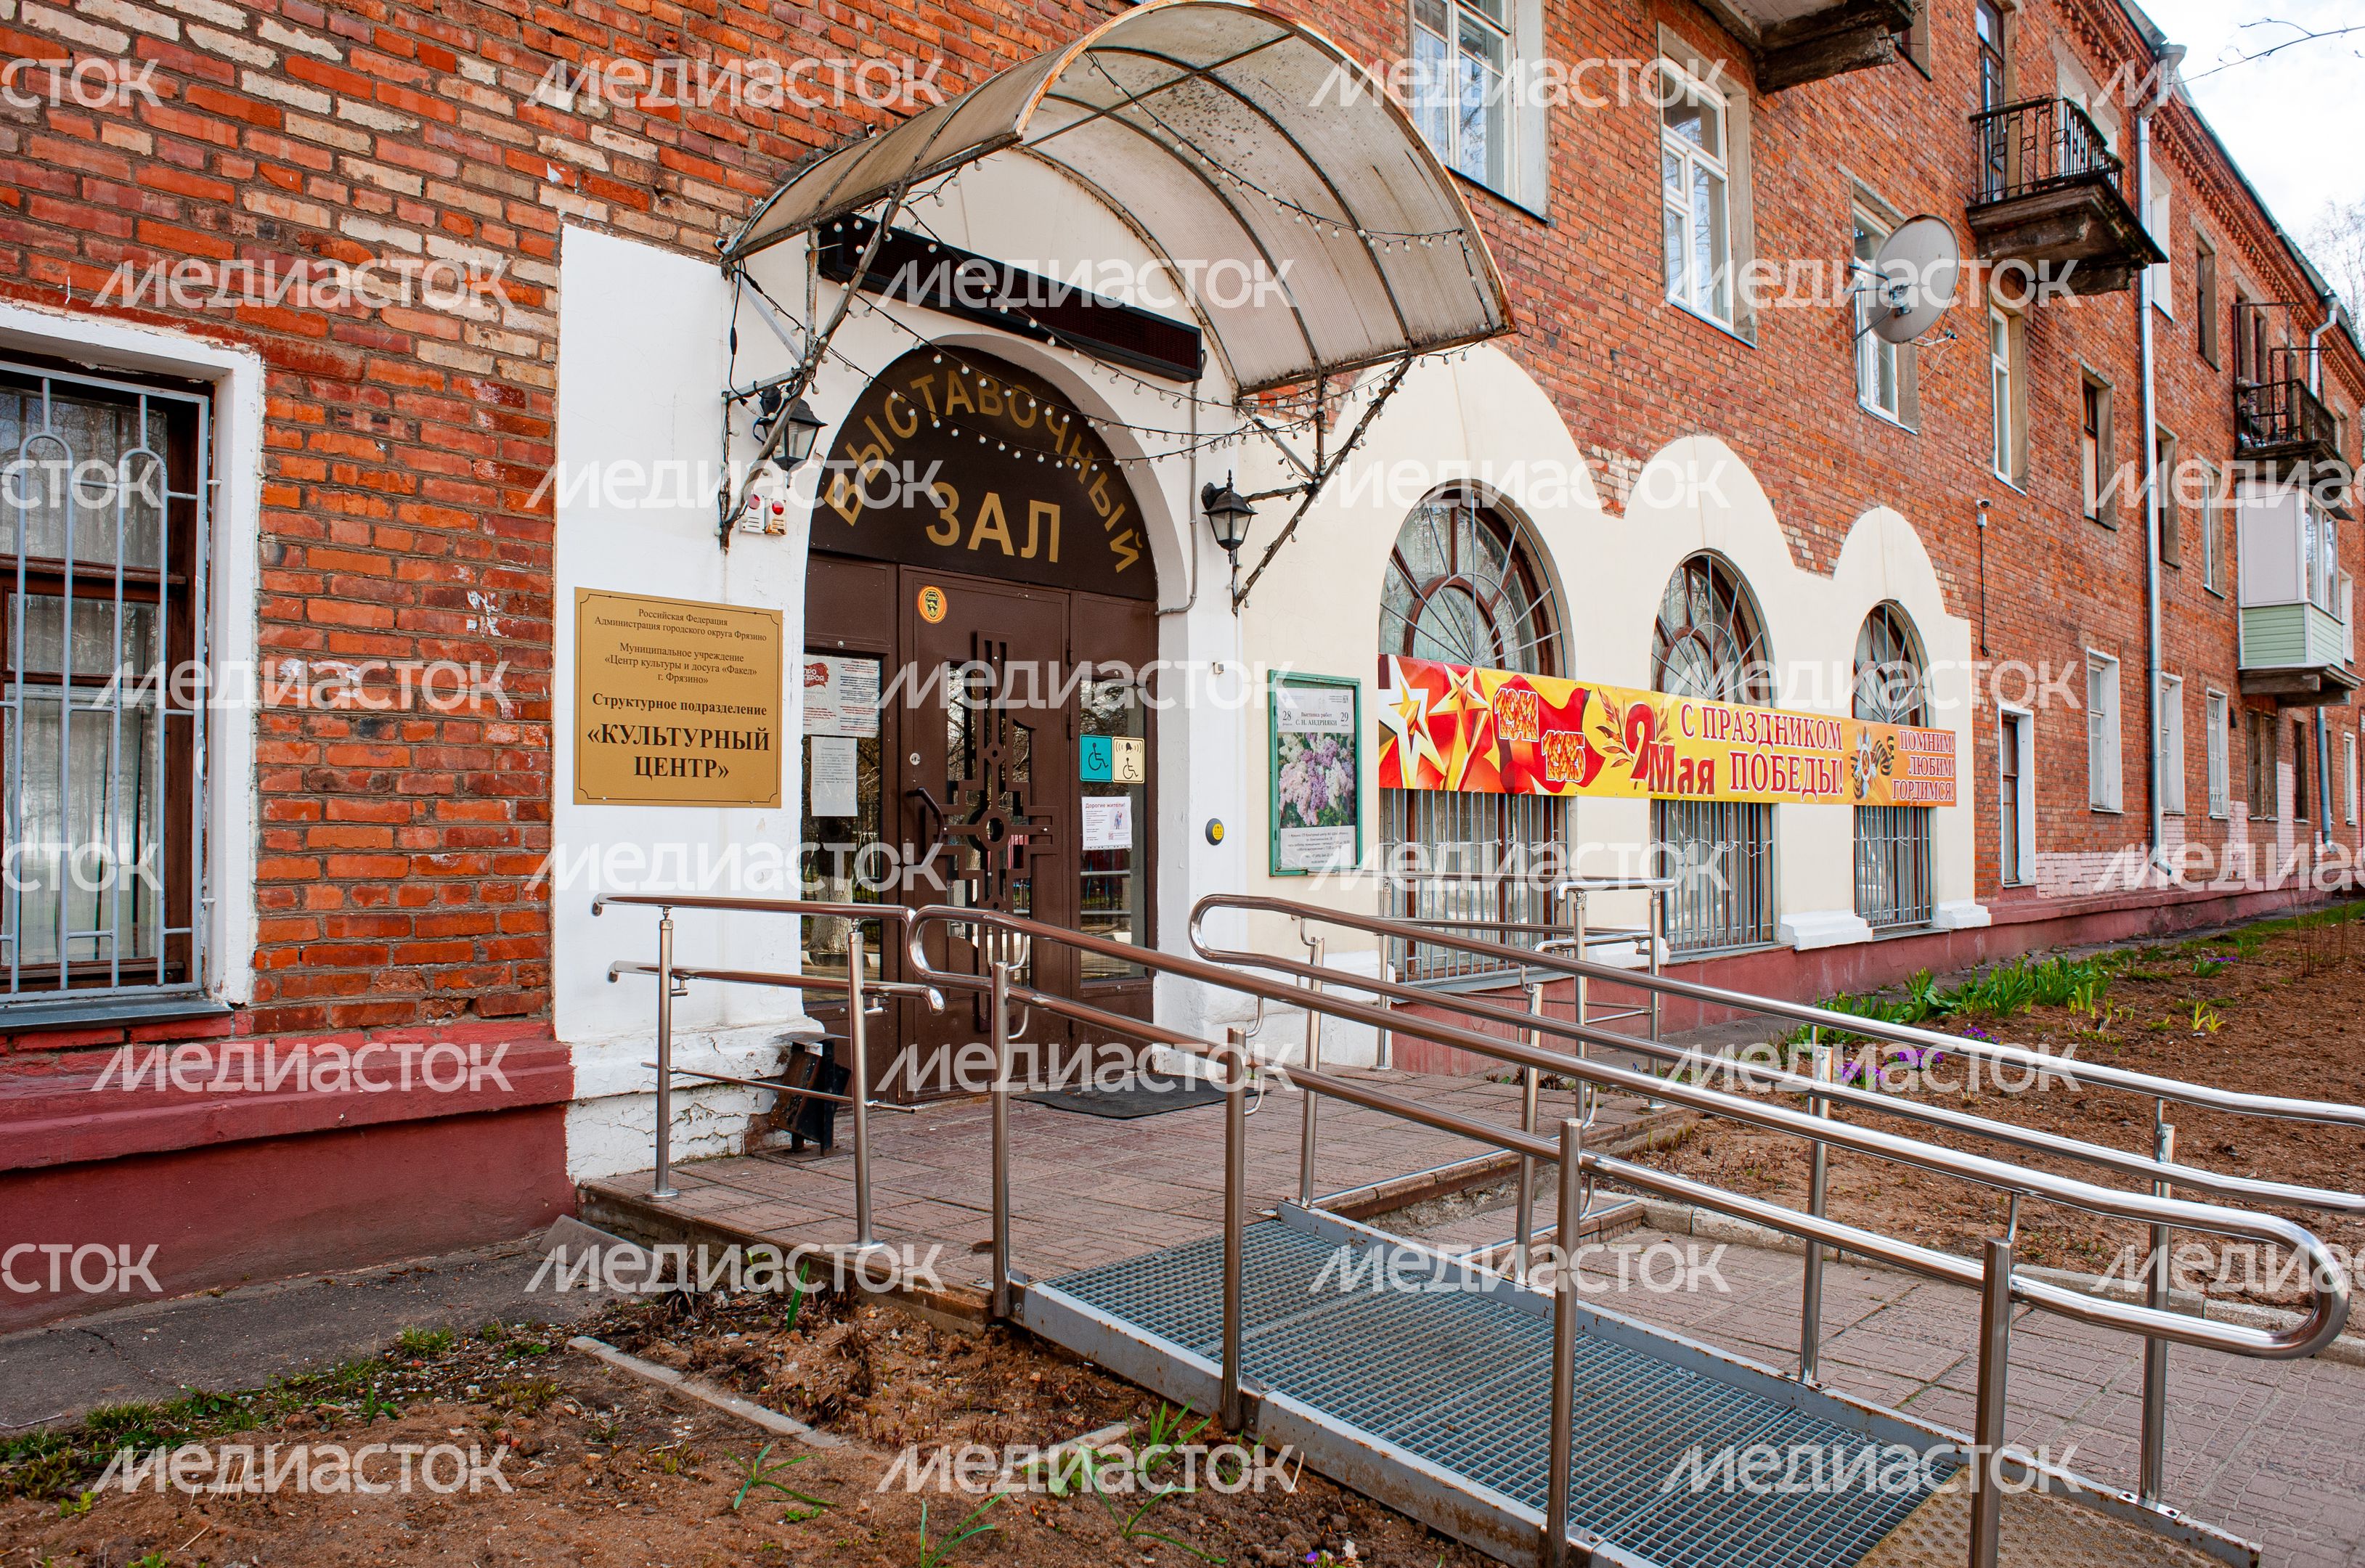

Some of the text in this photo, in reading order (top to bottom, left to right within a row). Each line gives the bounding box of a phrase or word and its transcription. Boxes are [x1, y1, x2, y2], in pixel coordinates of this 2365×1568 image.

[824, 370, 1143, 573] ВЫСТАВОЧНЫЙ
[926, 482, 1060, 563] ЗАЛ
[595, 616, 767, 642] Администрация городского округа Фрязино
[638, 608, 728, 626] Российская Федерация
[619, 642, 744, 663] Муниципальное учреждение
[605, 655, 638, 668] «Центр
[640, 660, 682, 671] культуры
[691, 664, 720, 675] досуга
[722, 665, 757, 676] «Факел»
[666, 673, 709, 685] Фрязино»
[593, 693, 767, 716] Структурное подразделение
[1282, 711, 1292, 722] 28
[1340, 711, 1349, 722] 29
[1494, 687, 1539, 743] 1941
[587, 723, 770, 751] «КУЛЬТУРНЫЙ
[1680, 703, 1844, 754] С ПРАЗДНИКОМ
[1624, 702, 1715, 796] 9 Мая
[1898, 730, 1955, 754] ПОМНИМ!
[1541, 729, 1586, 783] 1945
[1907, 755, 1955, 777] ЛЮБИМ!
[634, 756, 730, 781] ЦЕНТР»
[1729, 751, 1844, 802] ПОБЕДЫ!
[1892, 780, 1955, 804] ГОРДИМСЯ!
